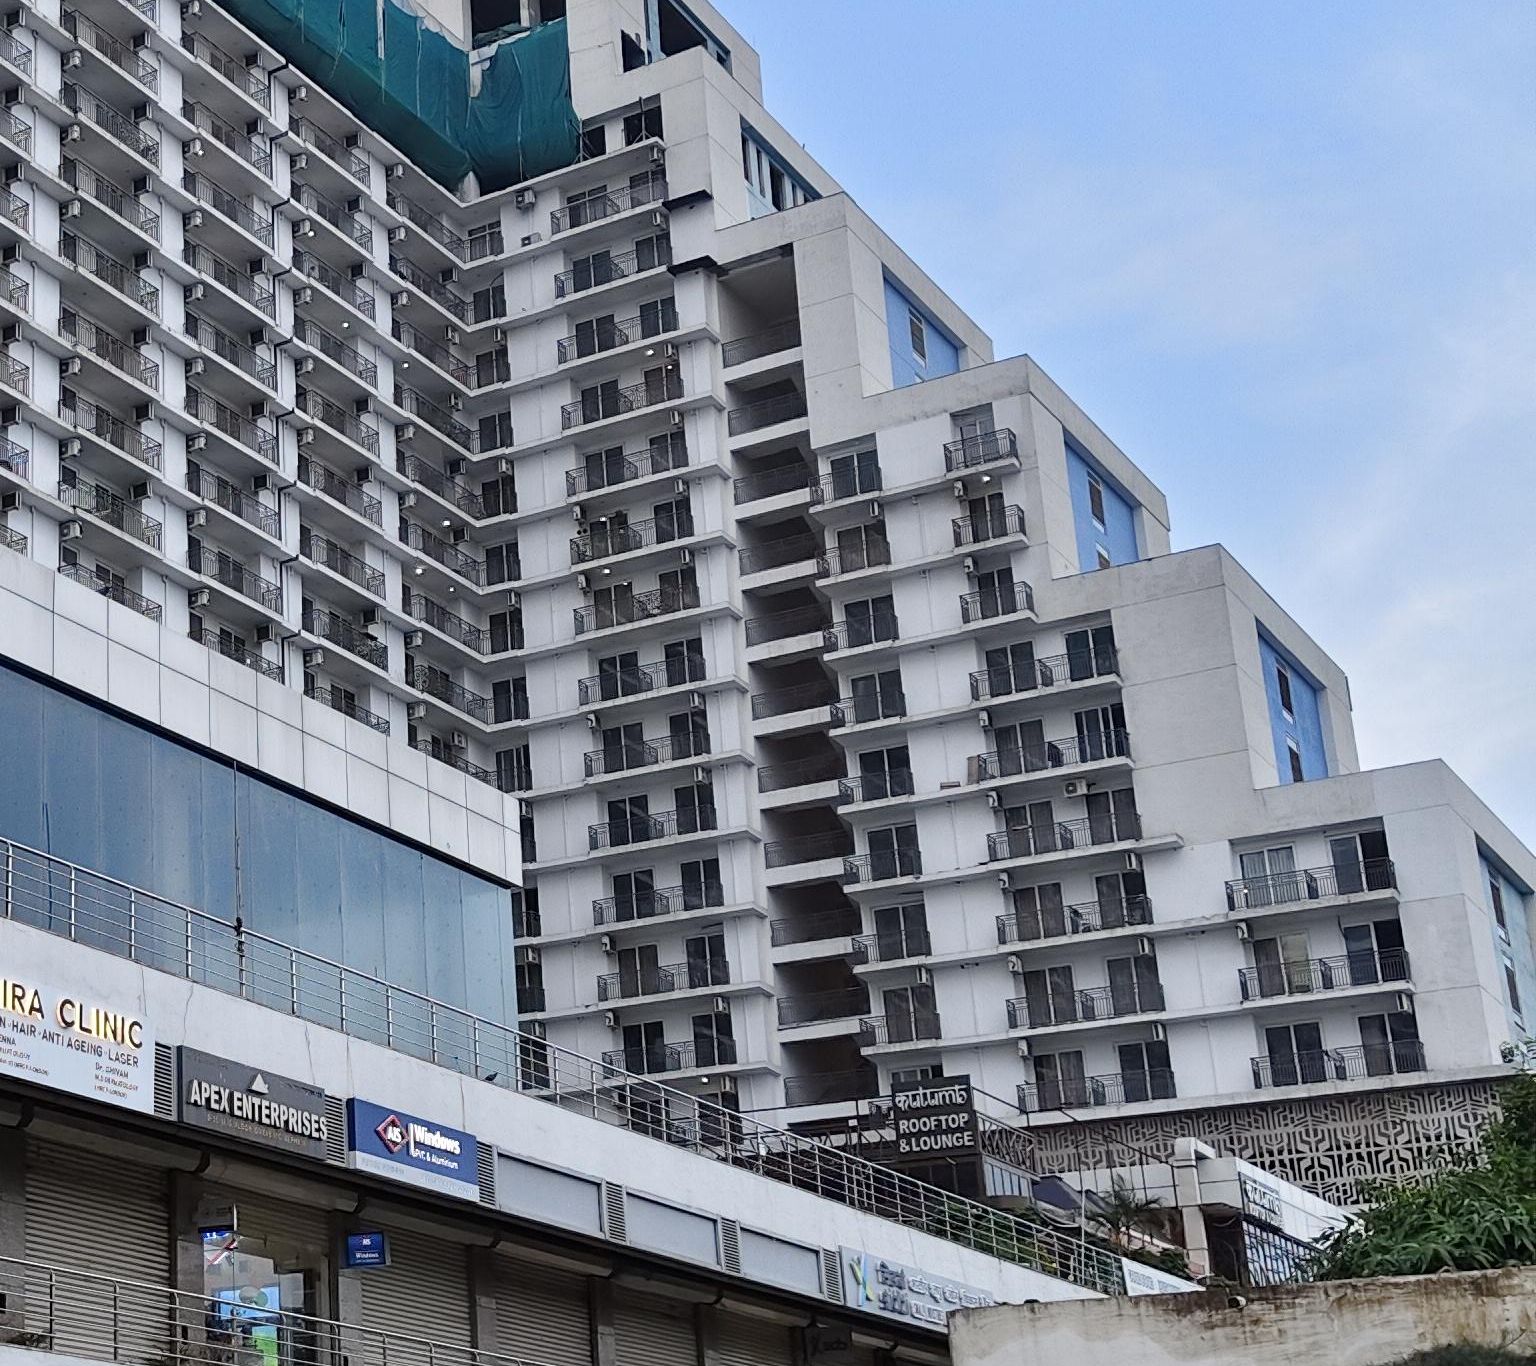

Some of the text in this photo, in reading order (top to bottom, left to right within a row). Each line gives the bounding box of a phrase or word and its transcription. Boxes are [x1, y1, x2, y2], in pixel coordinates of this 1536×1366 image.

[57, 997, 143, 1050] CLINIC
[13, 1020, 37, 1037] HAIR
[41, 1029, 64, 1047] ANTI
[66, 1037, 103, 1058] AGEING
[108, 1048, 139, 1068] LASER
[190, 1079, 230, 1114] APEX
[233, 1091, 328, 1141] ENTERPRISES
[898, 1113, 969, 1134] ROOFTOP
[413, 1124, 461, 1155] Windows
[911, 1131, 975, 1152] LOUNGE
